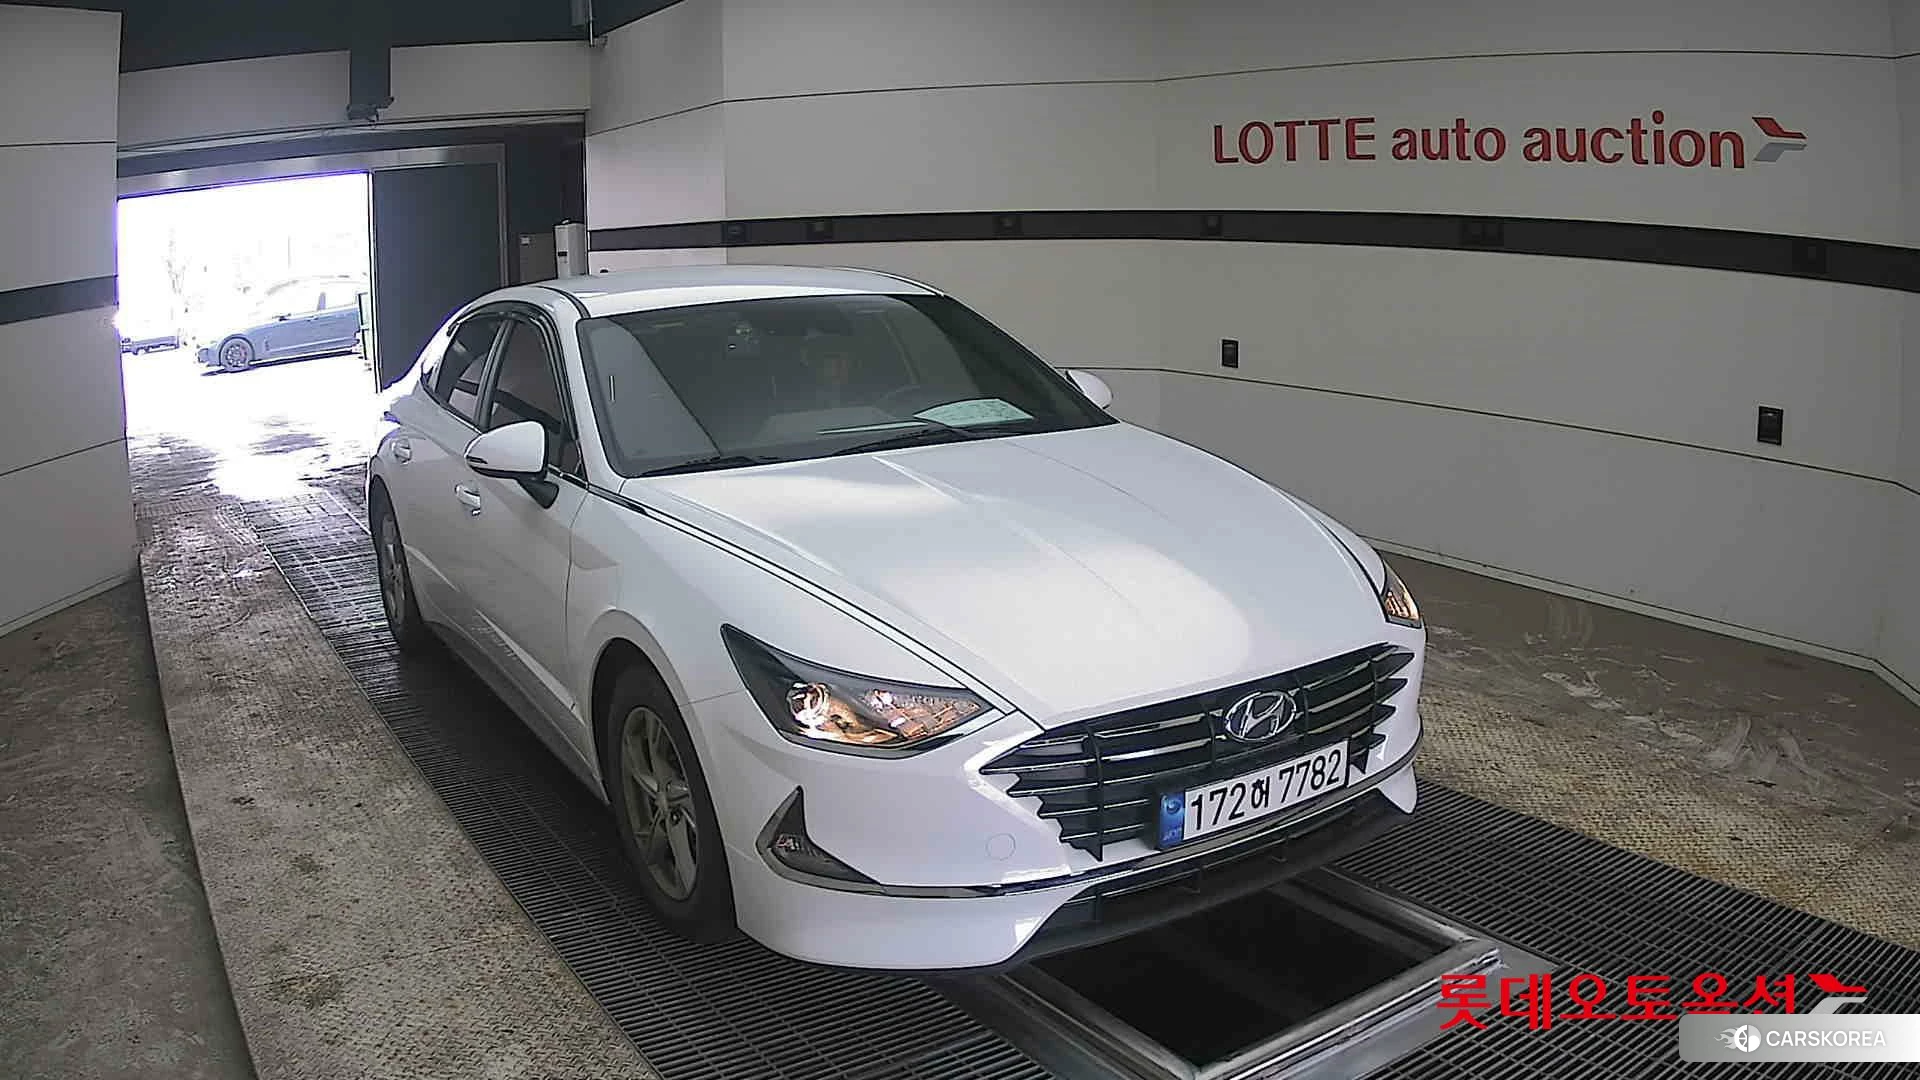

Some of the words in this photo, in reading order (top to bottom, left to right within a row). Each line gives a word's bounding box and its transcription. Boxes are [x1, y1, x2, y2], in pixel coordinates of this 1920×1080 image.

[1213, 117, 1376, 164] LOTTE
[1391, 117, 1507, 161] auto
[1522, 110, 1745, 169] auction
[1279, 749, 1342, 804] 7782
